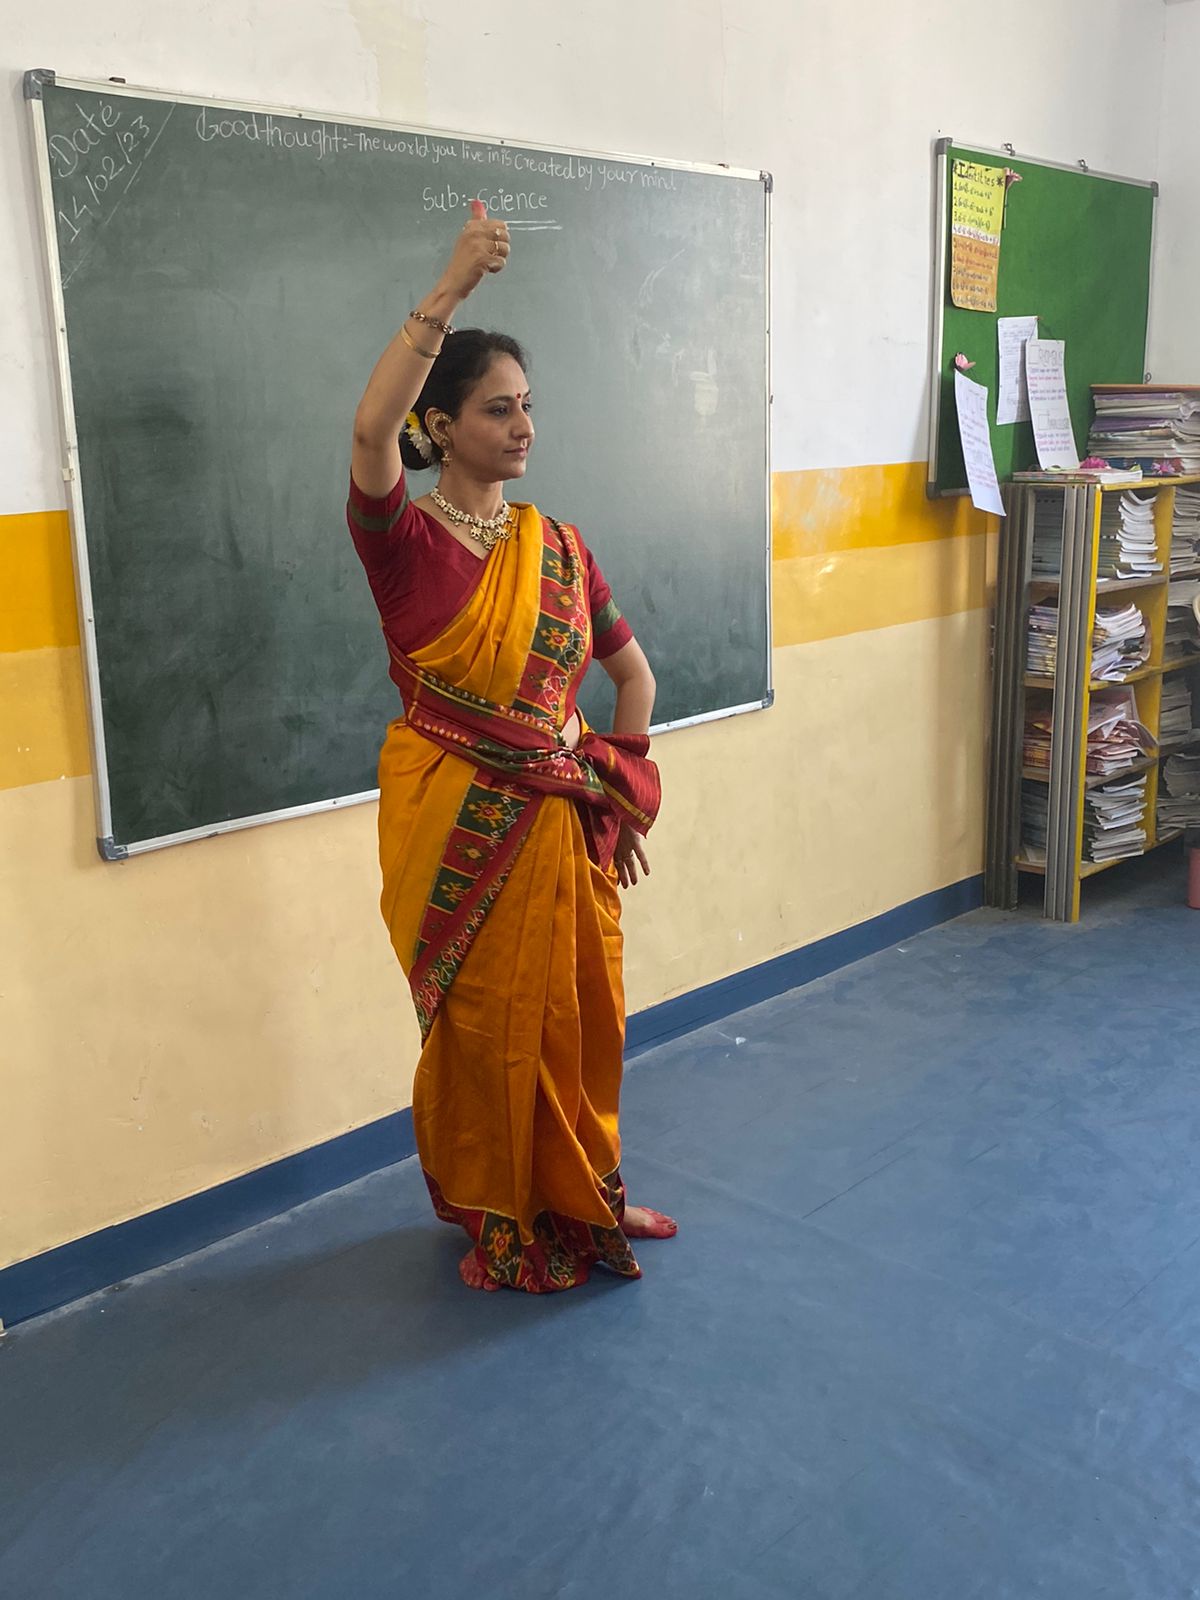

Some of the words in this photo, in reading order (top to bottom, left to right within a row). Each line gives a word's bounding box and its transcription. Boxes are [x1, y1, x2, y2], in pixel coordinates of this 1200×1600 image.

[49, 100, 120, 177] Date
[354, 132, 380, 152] The
[382, 136, 428, 158] world
[431, 143, 457, 164] you
[462, 141, 484, 162] live
[577, 158, 594, 191] by
[599, 165, 638, 190] your
